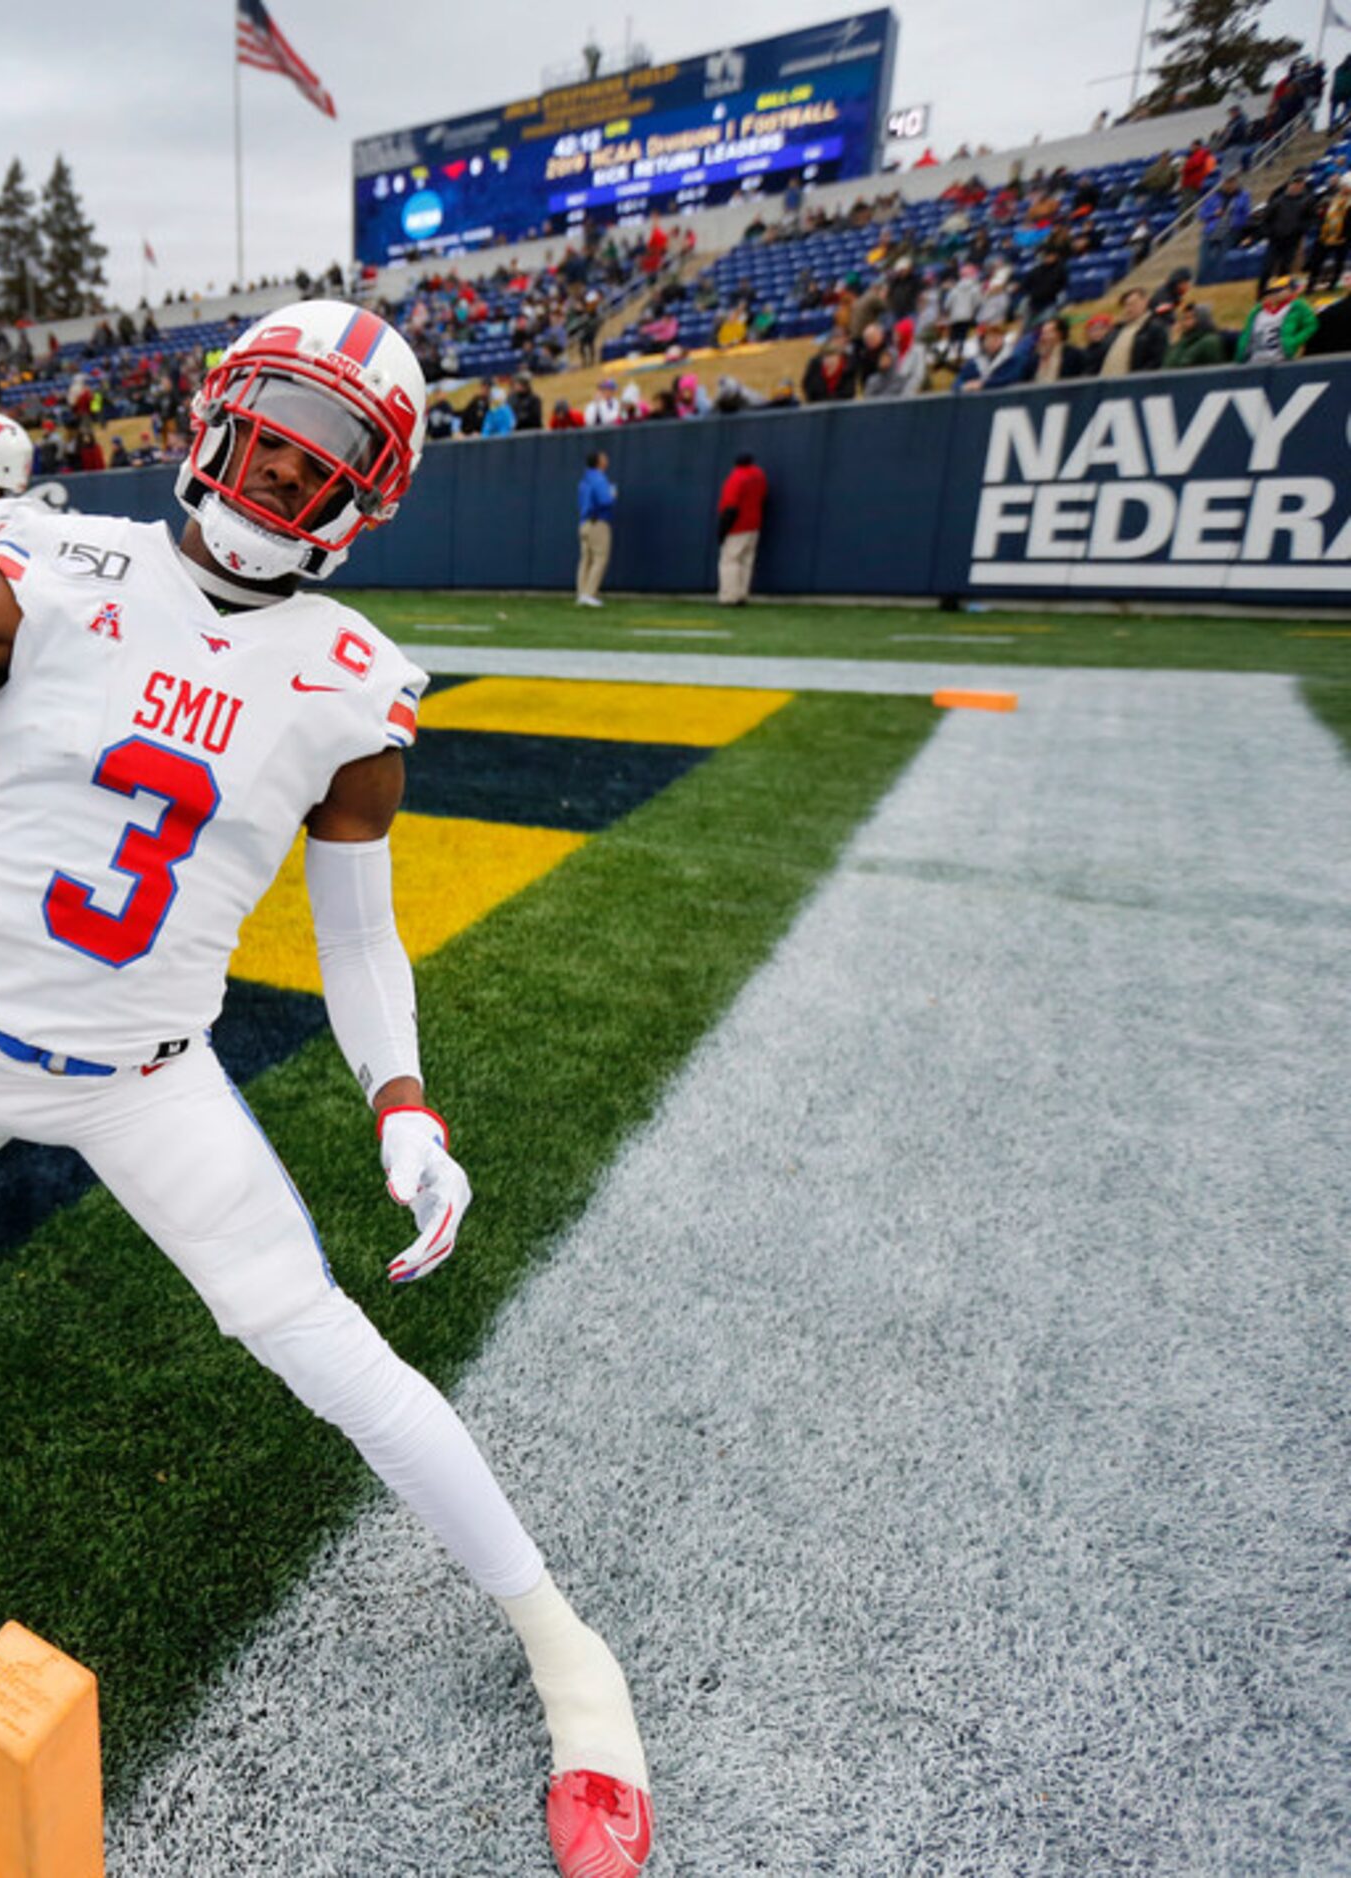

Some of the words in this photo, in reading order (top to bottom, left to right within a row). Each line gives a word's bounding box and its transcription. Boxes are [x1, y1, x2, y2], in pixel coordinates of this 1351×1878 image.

[888, 112, 922, 137] 40
[590, 139, 641, 168] NCAA
[633, 150, 700, 179] RETURN
[703, 131, 785, 165] LEADERS
[983, 381, 1331, 482] NAVY
[58, 541, 131, 581] 150
[333, 629, 372, 675] C
[132, 670, 244, 755] SMU
[42, 734, 222, 969] 3
